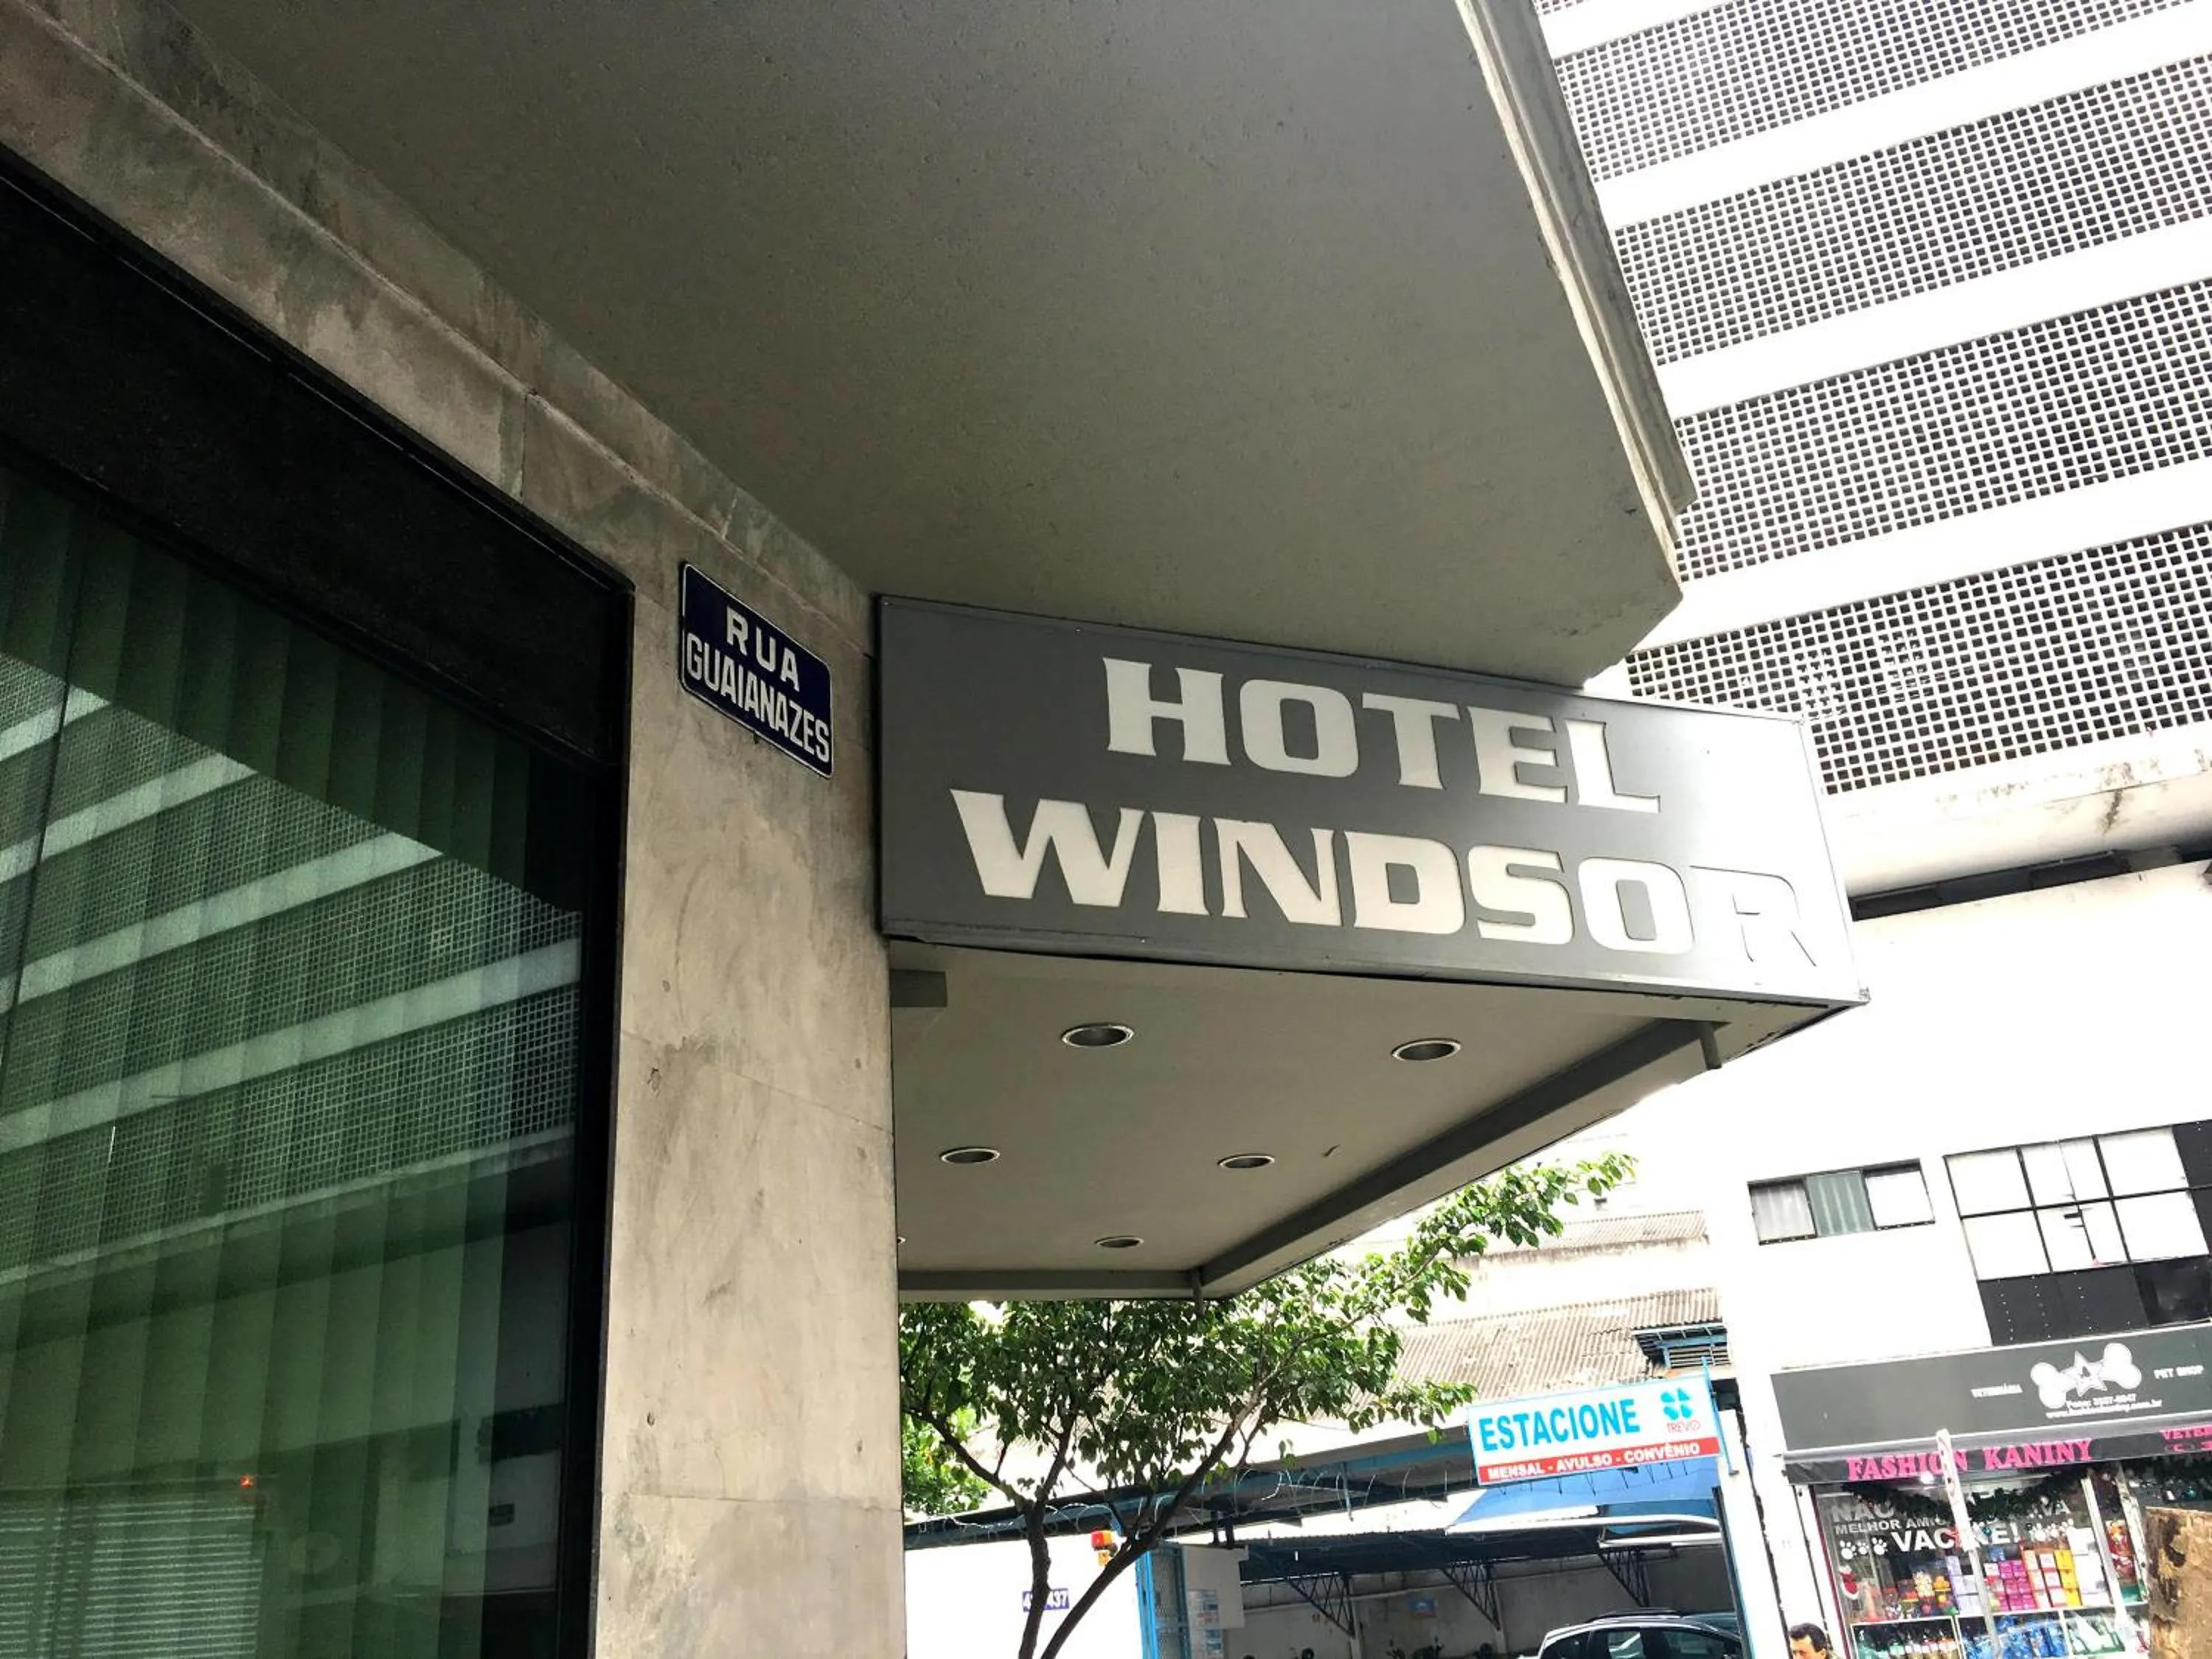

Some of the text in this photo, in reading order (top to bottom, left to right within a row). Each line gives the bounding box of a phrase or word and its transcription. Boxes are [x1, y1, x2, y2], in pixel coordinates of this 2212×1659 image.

[726, 606, 800, 692] RUA
[686, 632, 830, 763] GUAIANAZES
[1103, 656, 1661, 813] HOTEL
[949, 788, 1818, 985] WINDSOR
[1478, 1398, 1641, 1452] ESTACIONE
[1983, 1438, 2092, 1470] KANINY
[1488, 1459, 1545, 1479] MENSAL
[1557, 1451, 1613, 1472] AVULSO
[1624, 1442, 1700, 1464] CONVÊNIO
[1835, 1519, 1902, 1534] MELHOR
